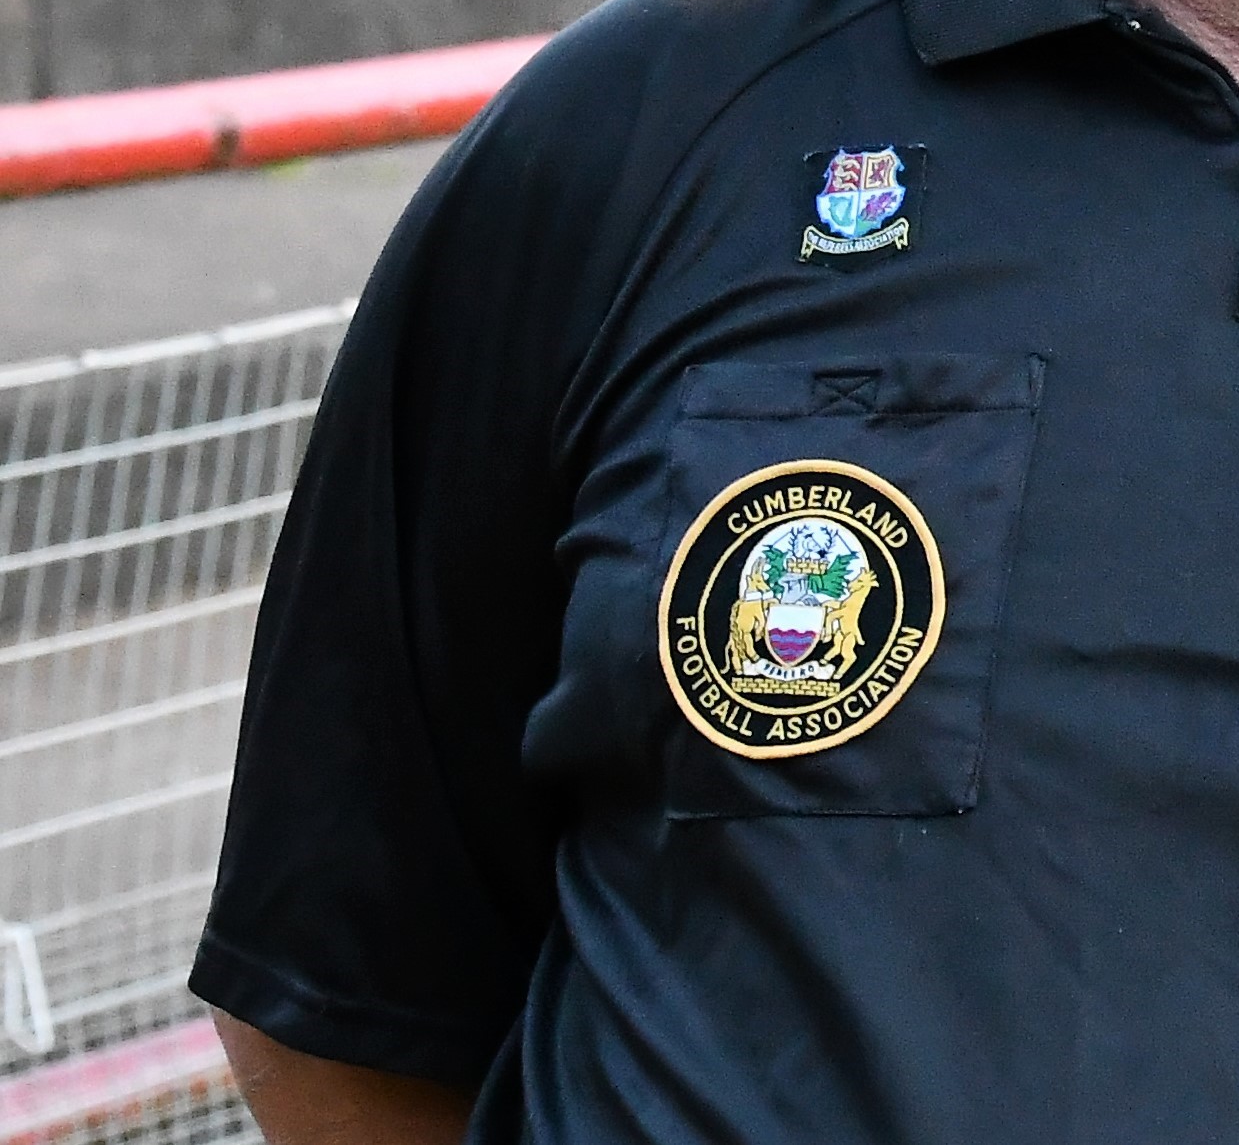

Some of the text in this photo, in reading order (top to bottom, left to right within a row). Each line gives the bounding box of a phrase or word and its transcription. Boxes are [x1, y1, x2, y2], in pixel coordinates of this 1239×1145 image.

[727, 485, 909, 548] CUMBERLAND
[675, 616, 924, 741] FOOTBALL ASSOCIATION
